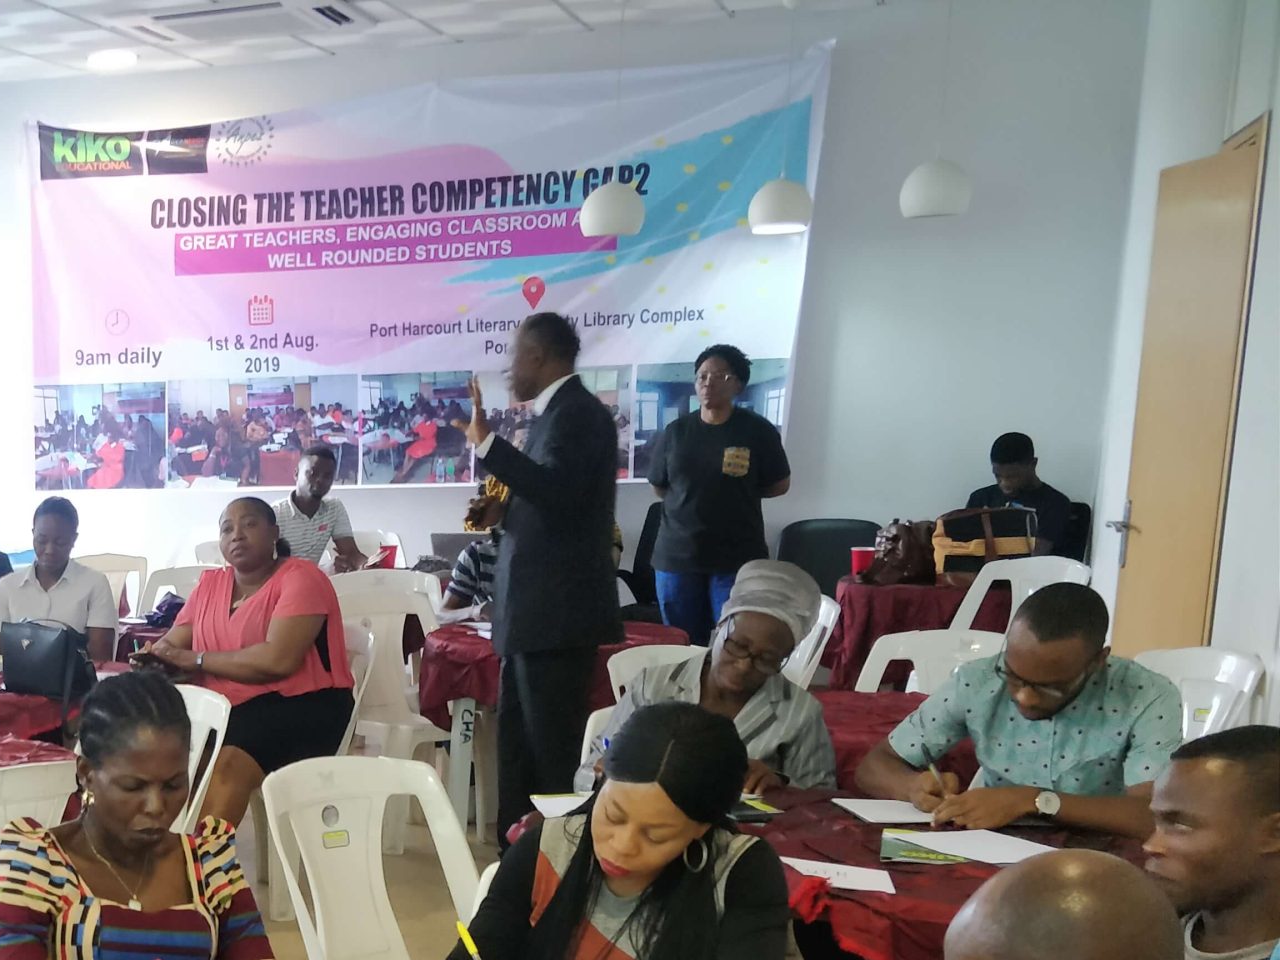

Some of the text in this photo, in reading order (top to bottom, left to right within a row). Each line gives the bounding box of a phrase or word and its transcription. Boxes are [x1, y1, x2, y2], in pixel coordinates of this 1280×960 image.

[150, 194, 247, 229] CLOSING
[254, 191, 295, 224] THE
[300, 184, 405, 221] TEACHER
[412, 169, 577, 213] COMPETENCY
[179, 233, 238, 252] GREAT
[243, 228, 340, 248] TEACHERS,
[346, 218, 442, 242] ENGAGING
[447, 212, 568, 236] CLASSROOM
[267, 239, 512, 270] WELL ROUNDED STUDENTS
[369, 322, 400, 338] Port
[402, 320, 462, 337] Harcourt
[584, 310, 636, 330] Library
[640, 306, 705, 327] Complex
[74, 346, 163, 368] 9am daily
[206, 332, 320, 352] 1st & 2nd Aug.
[244, 356, 281, 373] 2019
[461, 709, 474, 744] CHA
